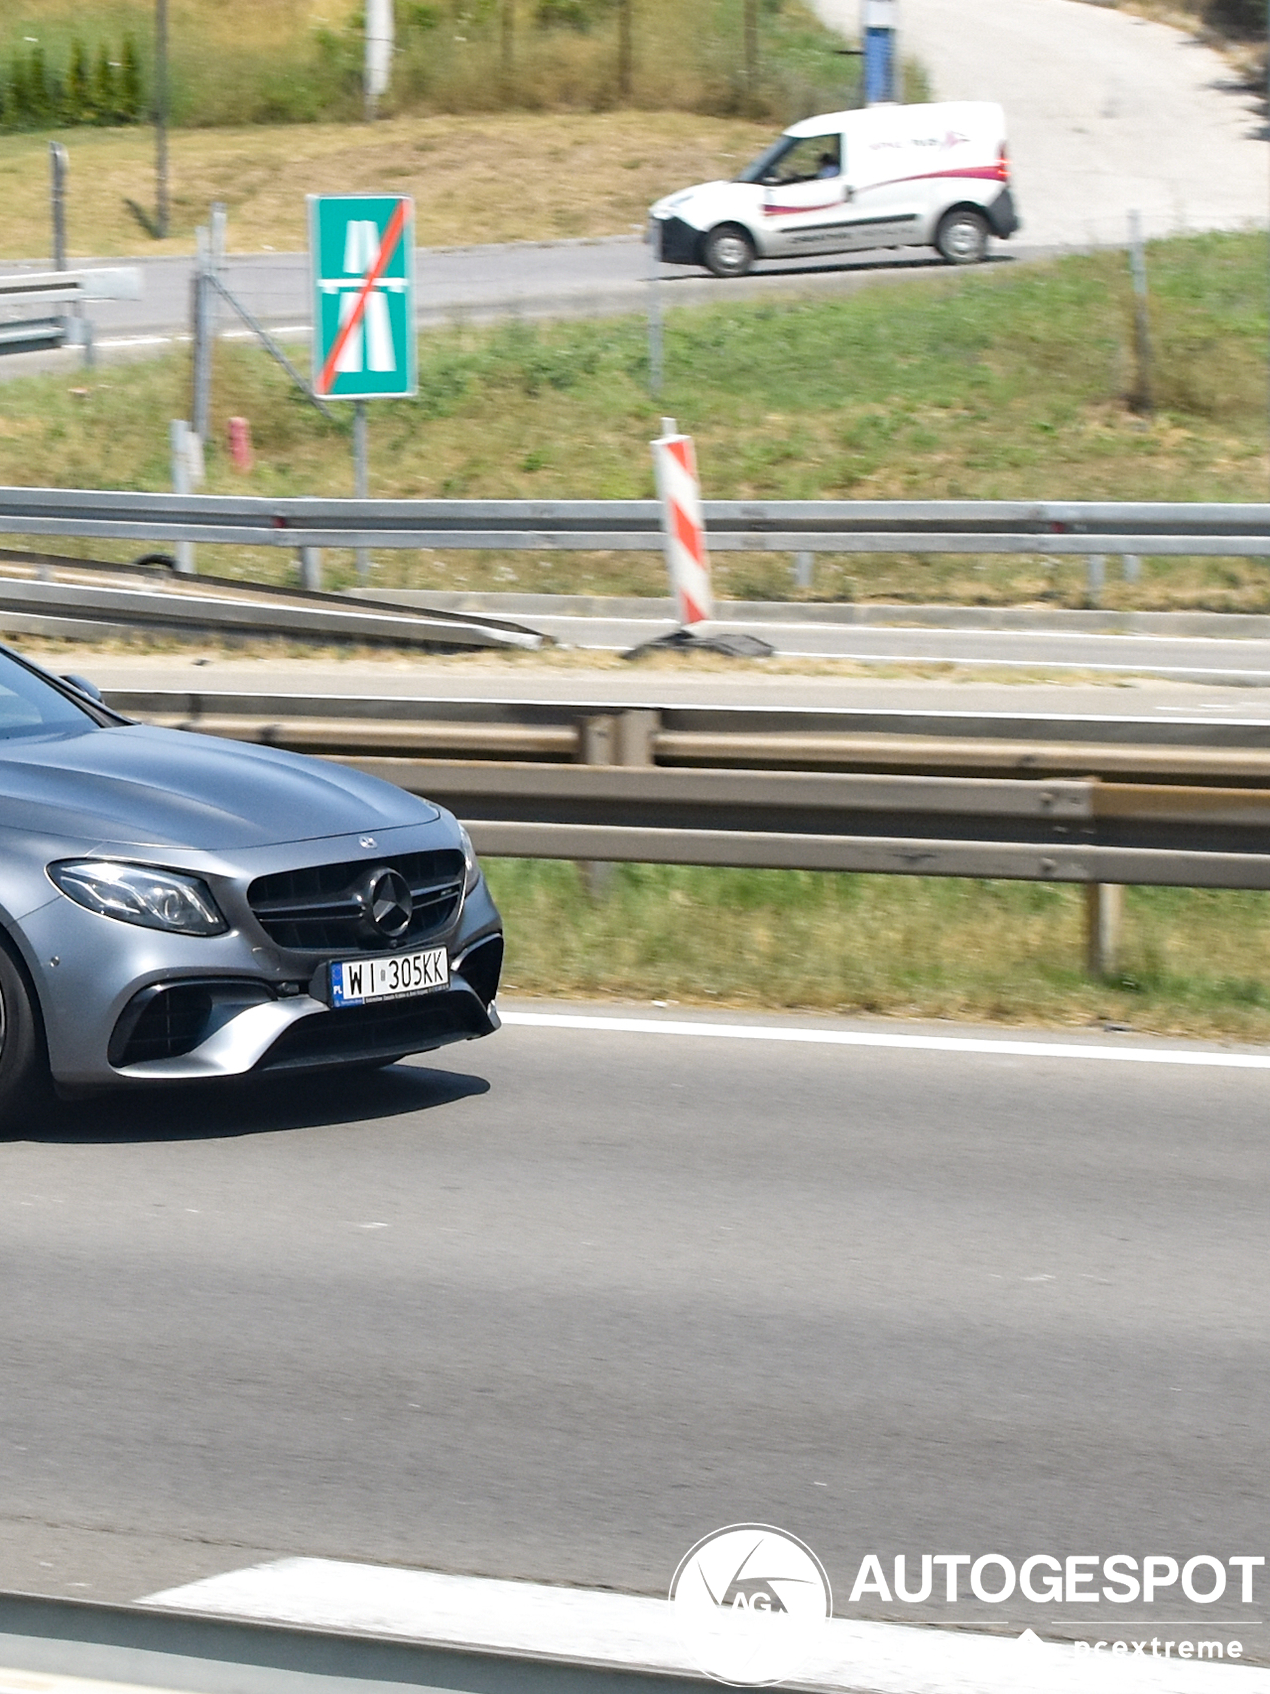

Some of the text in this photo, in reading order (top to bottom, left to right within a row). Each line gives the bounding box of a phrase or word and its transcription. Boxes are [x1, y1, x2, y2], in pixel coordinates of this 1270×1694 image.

[348, 962, 375, 996] WI
[388, 950, 444, 990] 305KK
[333, 985, 343, 996] PL
